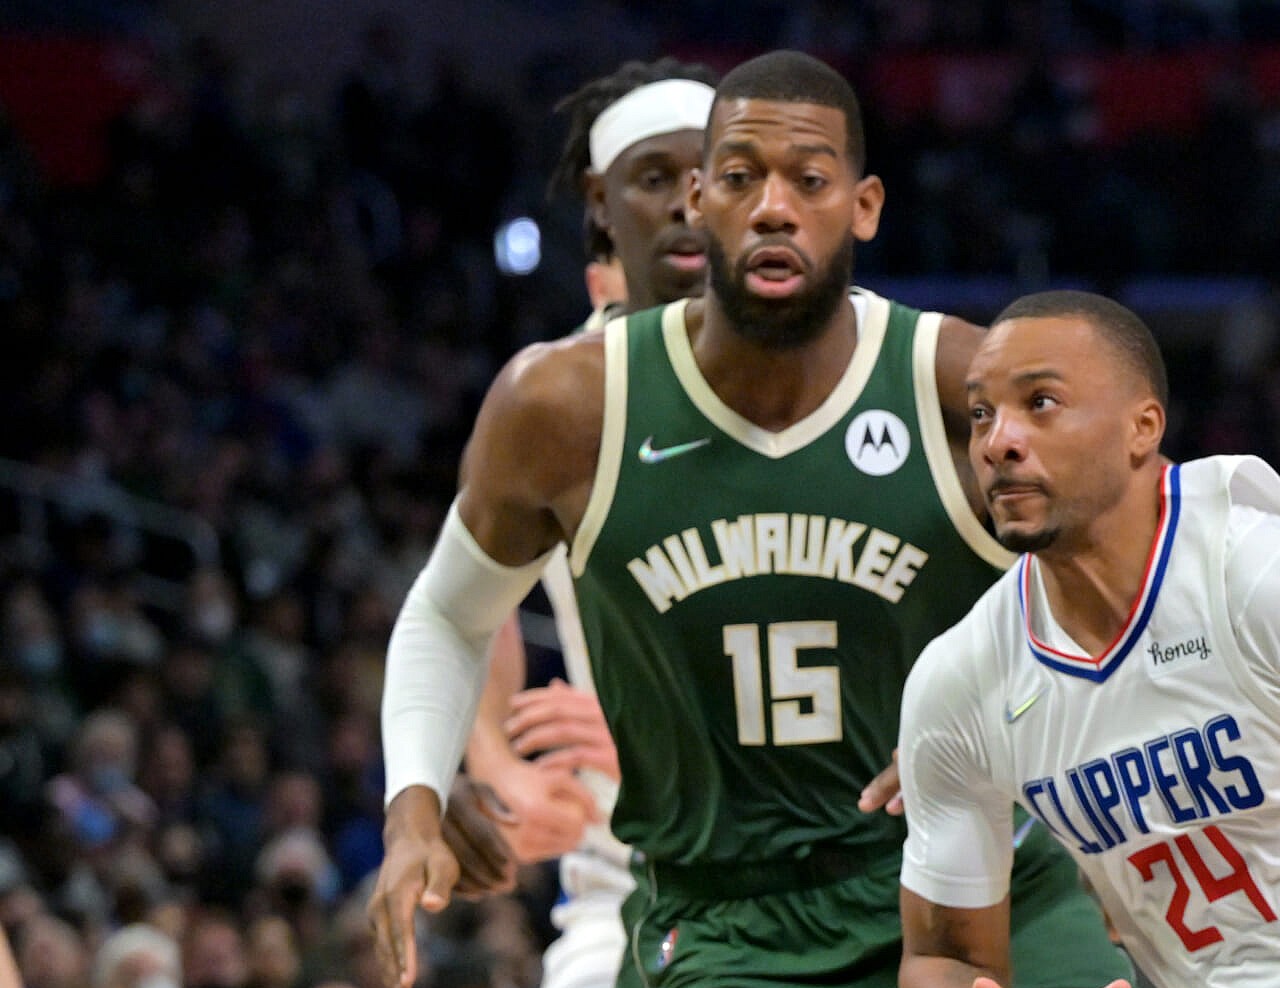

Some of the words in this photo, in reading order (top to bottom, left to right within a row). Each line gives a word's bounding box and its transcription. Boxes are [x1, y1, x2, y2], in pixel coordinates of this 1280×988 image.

[626, 512, 930, 615] MILWAUKEE
[722, 620, 843, 746] 15
[1147, 636, 1212, 666] honey
[1022, 713, 1265, 855] CLIPPERS
[1126, 825, 1278, 953] 24
